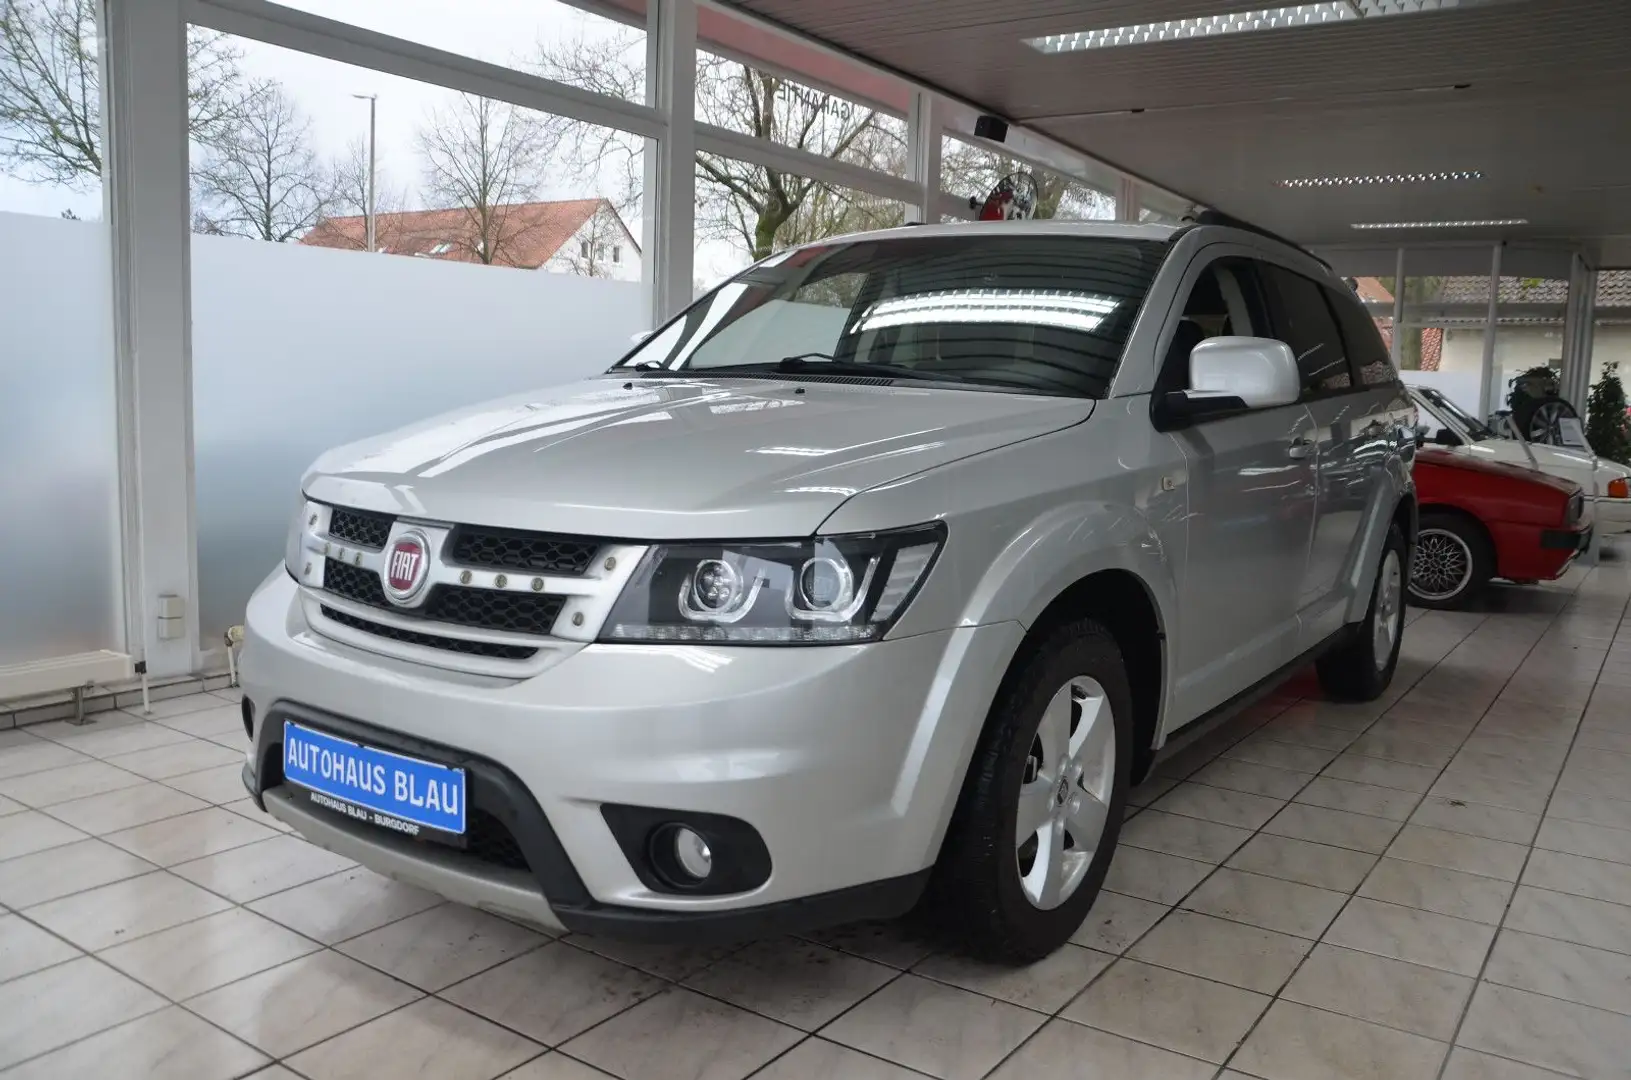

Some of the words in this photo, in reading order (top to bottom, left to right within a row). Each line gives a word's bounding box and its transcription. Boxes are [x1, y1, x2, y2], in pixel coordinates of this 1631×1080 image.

[390, 550, 419, 581] FIAT
[287, 737, 386, 796] AUTOHAUS
[394, 770, 458, 816] BLAU
[310, 792, 347, 813] AUTOHAUS
[347, 805, 367, 821] BLAU
[374, 813, 420, 836] BURGDORF
